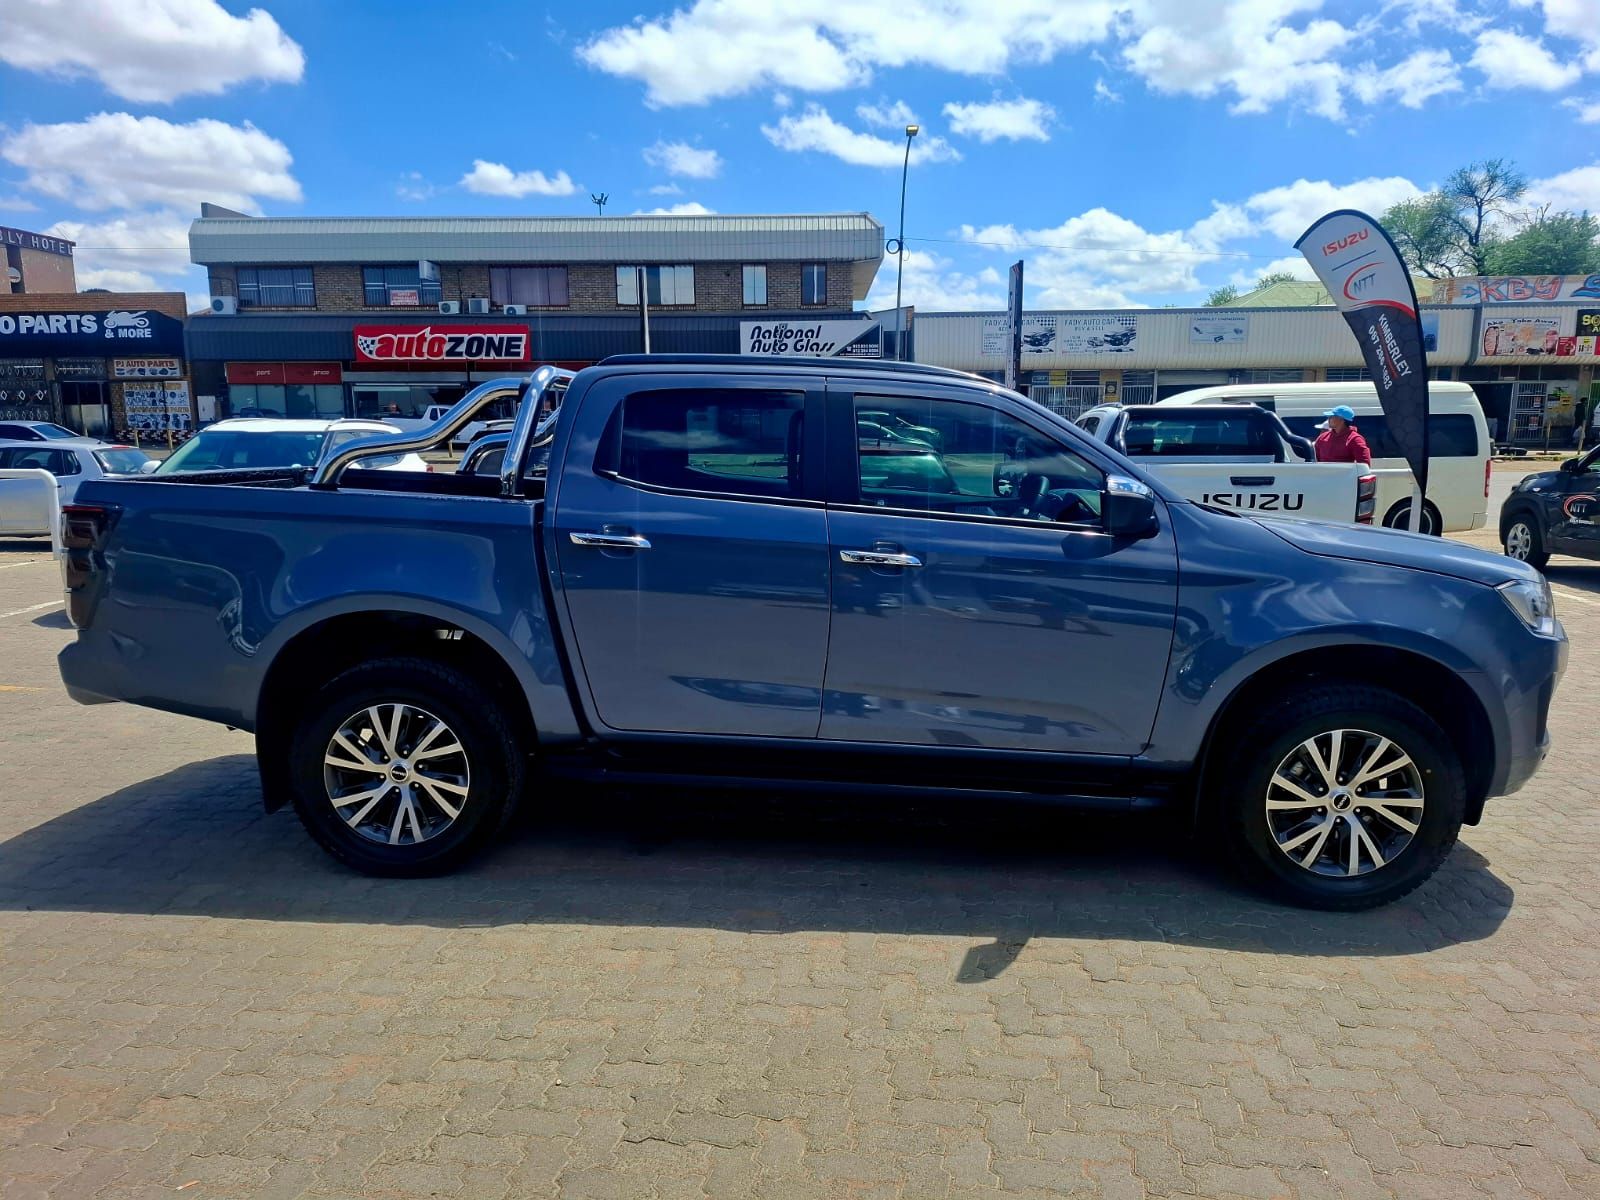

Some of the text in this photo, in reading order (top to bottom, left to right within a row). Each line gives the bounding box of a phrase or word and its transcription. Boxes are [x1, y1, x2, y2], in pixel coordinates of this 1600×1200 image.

[31, 235, 73, 256] HOTEL
[1322, 228, 1369, 256] ISUZU
[1353, 273, 1376, 293] NTT
[19, 315, 98, 334] PARTS
[104, 328, 152, 339] & MORE
[750, 325, 821, 339] National
[750, 339, 835, 352] Auto Glass
[1378, 313, 1412, 377] KIMBERLEY
[1569, 503, 1587, 513] NTT
